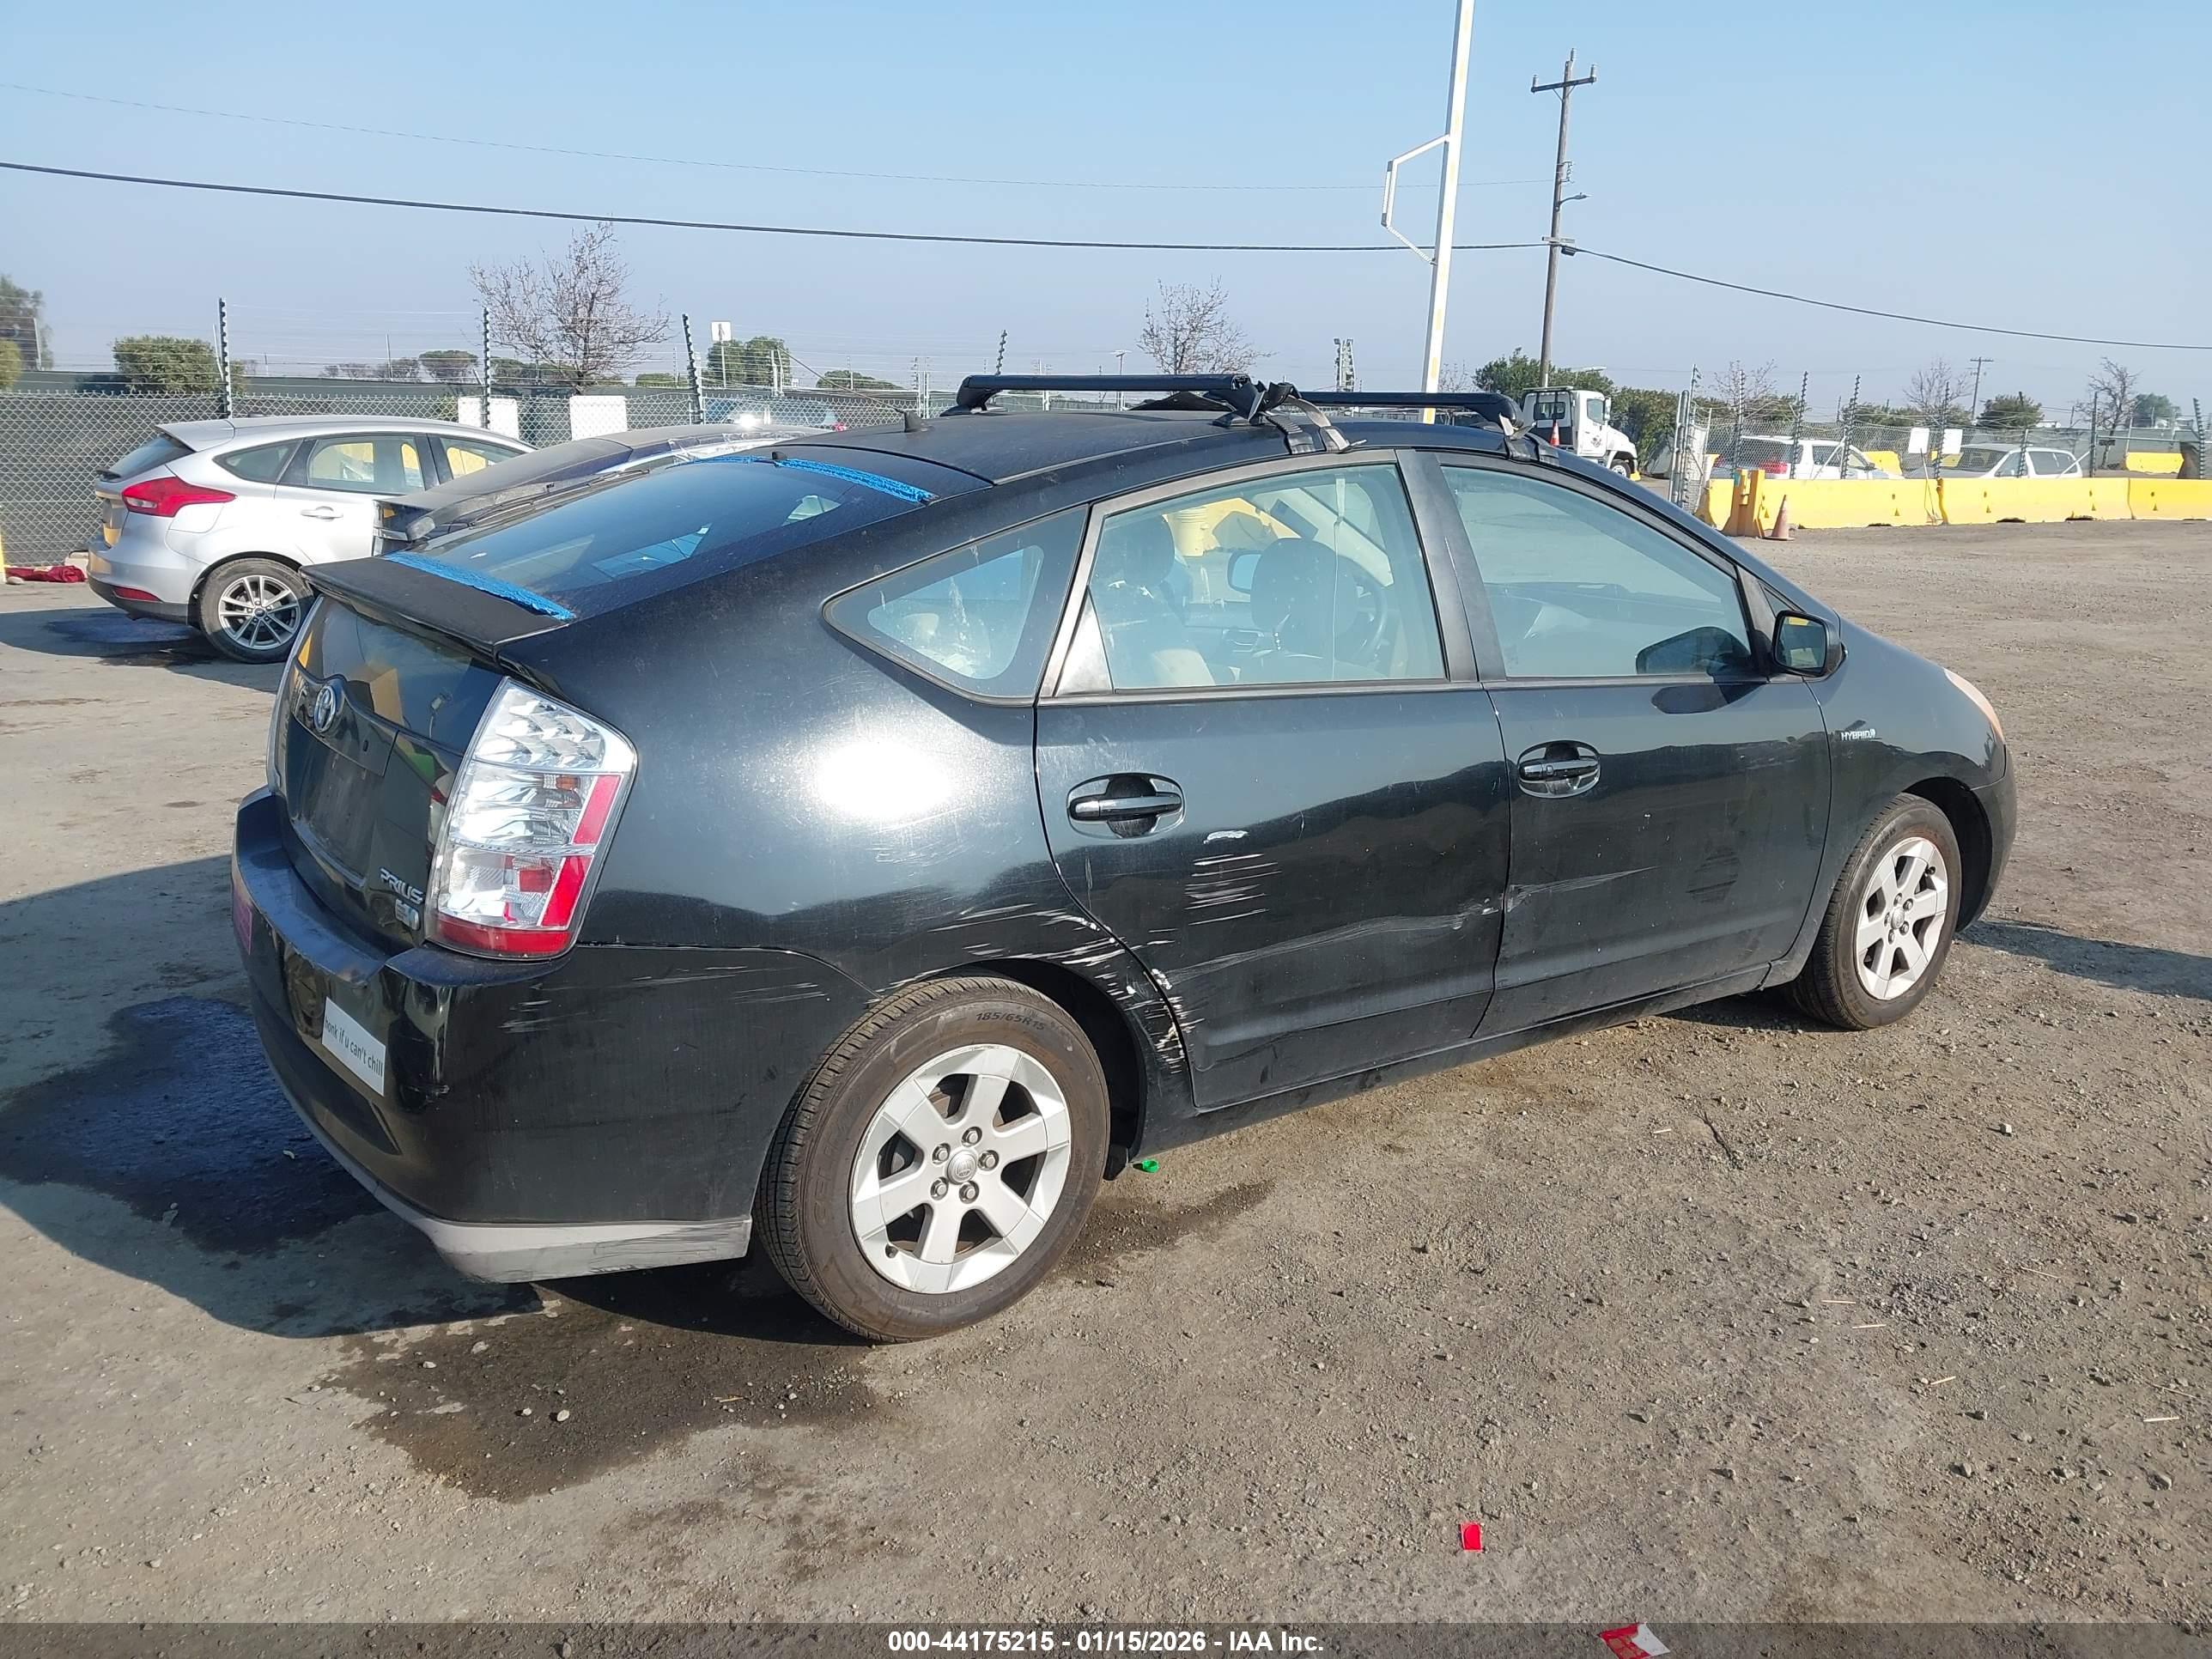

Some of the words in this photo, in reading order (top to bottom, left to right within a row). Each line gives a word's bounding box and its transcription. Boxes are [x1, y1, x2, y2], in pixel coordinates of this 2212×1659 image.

[1841, 730, 1870, 741] HYBRID
[380, 867, 424, 905] PRIUS
[975, 1011, 1048, 1031] 185/65R15
[339, 1027, 345, 1045] if
[350, 1042, 367, 1065] can't
[368, 1055, 383, 1078] chill
